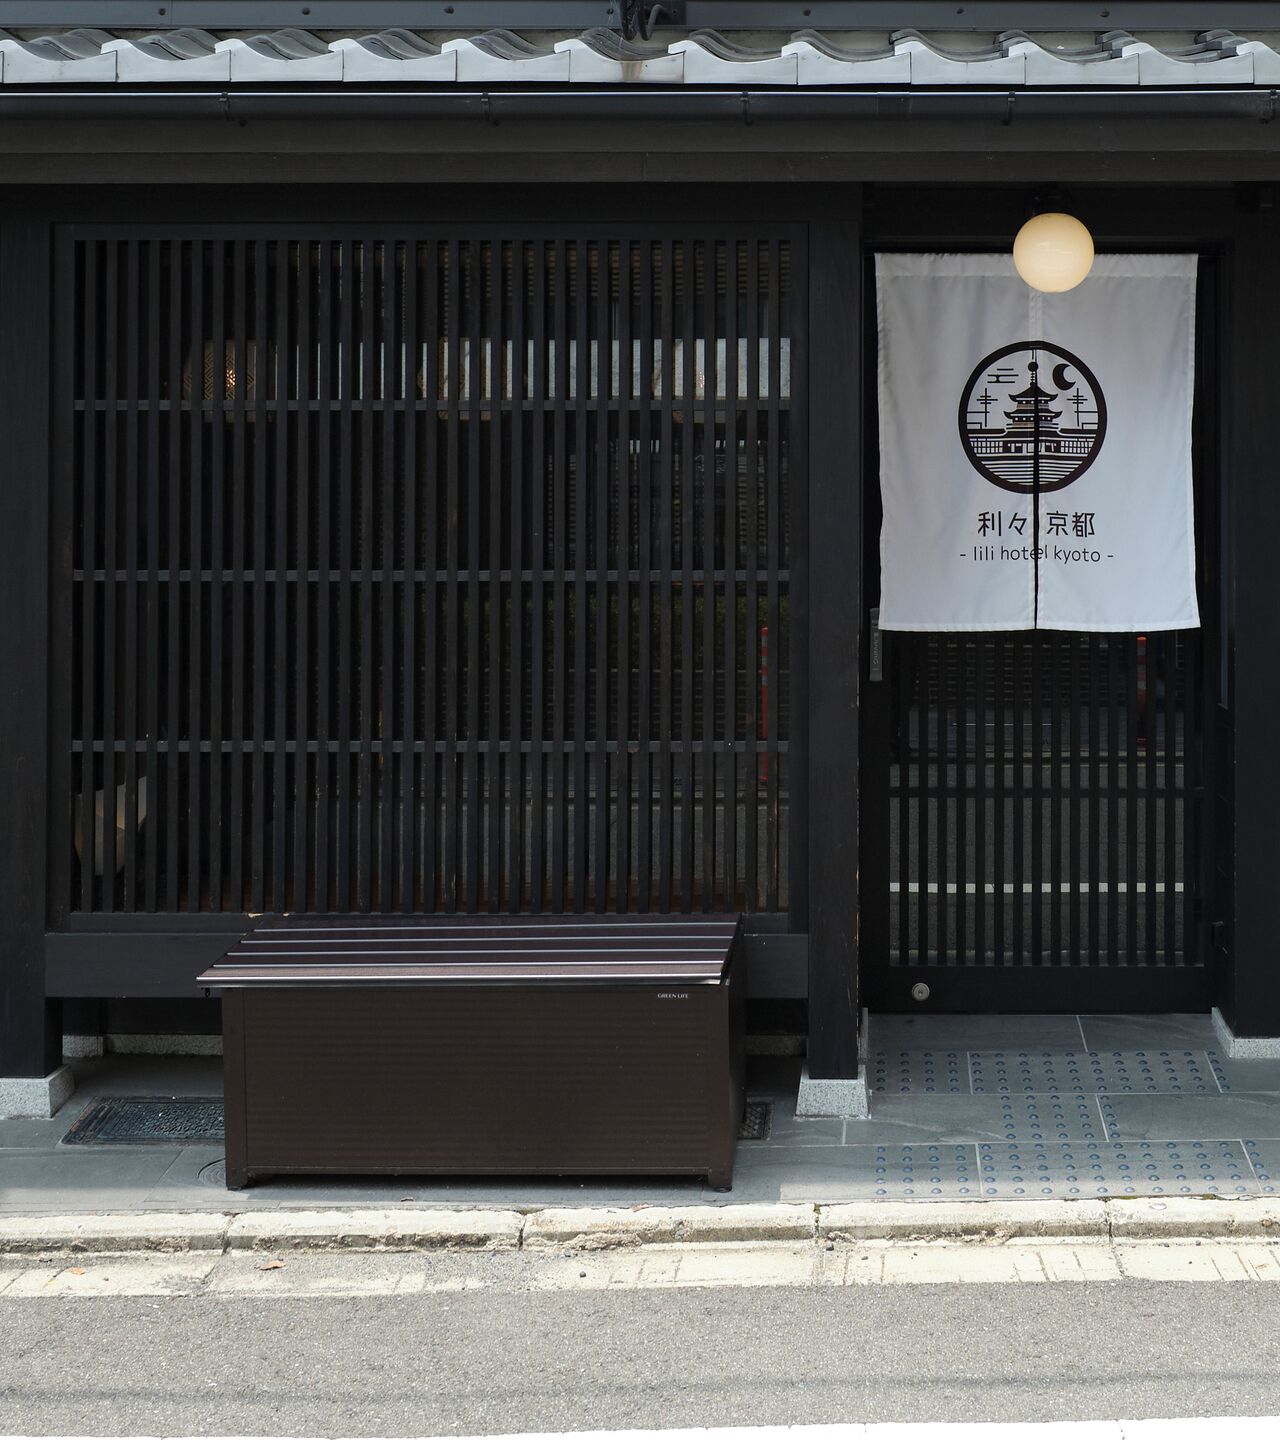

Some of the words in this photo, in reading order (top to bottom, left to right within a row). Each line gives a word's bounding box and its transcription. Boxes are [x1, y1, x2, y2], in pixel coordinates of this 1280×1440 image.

[977, 510, 1028, 537] 利々
[1046, 510, 1096, 538] 京都
[973, 545, 994, 561] lili
[1000, 544, 1048, 561] hotel
[1053, 544, 1101, 565] kyoto
